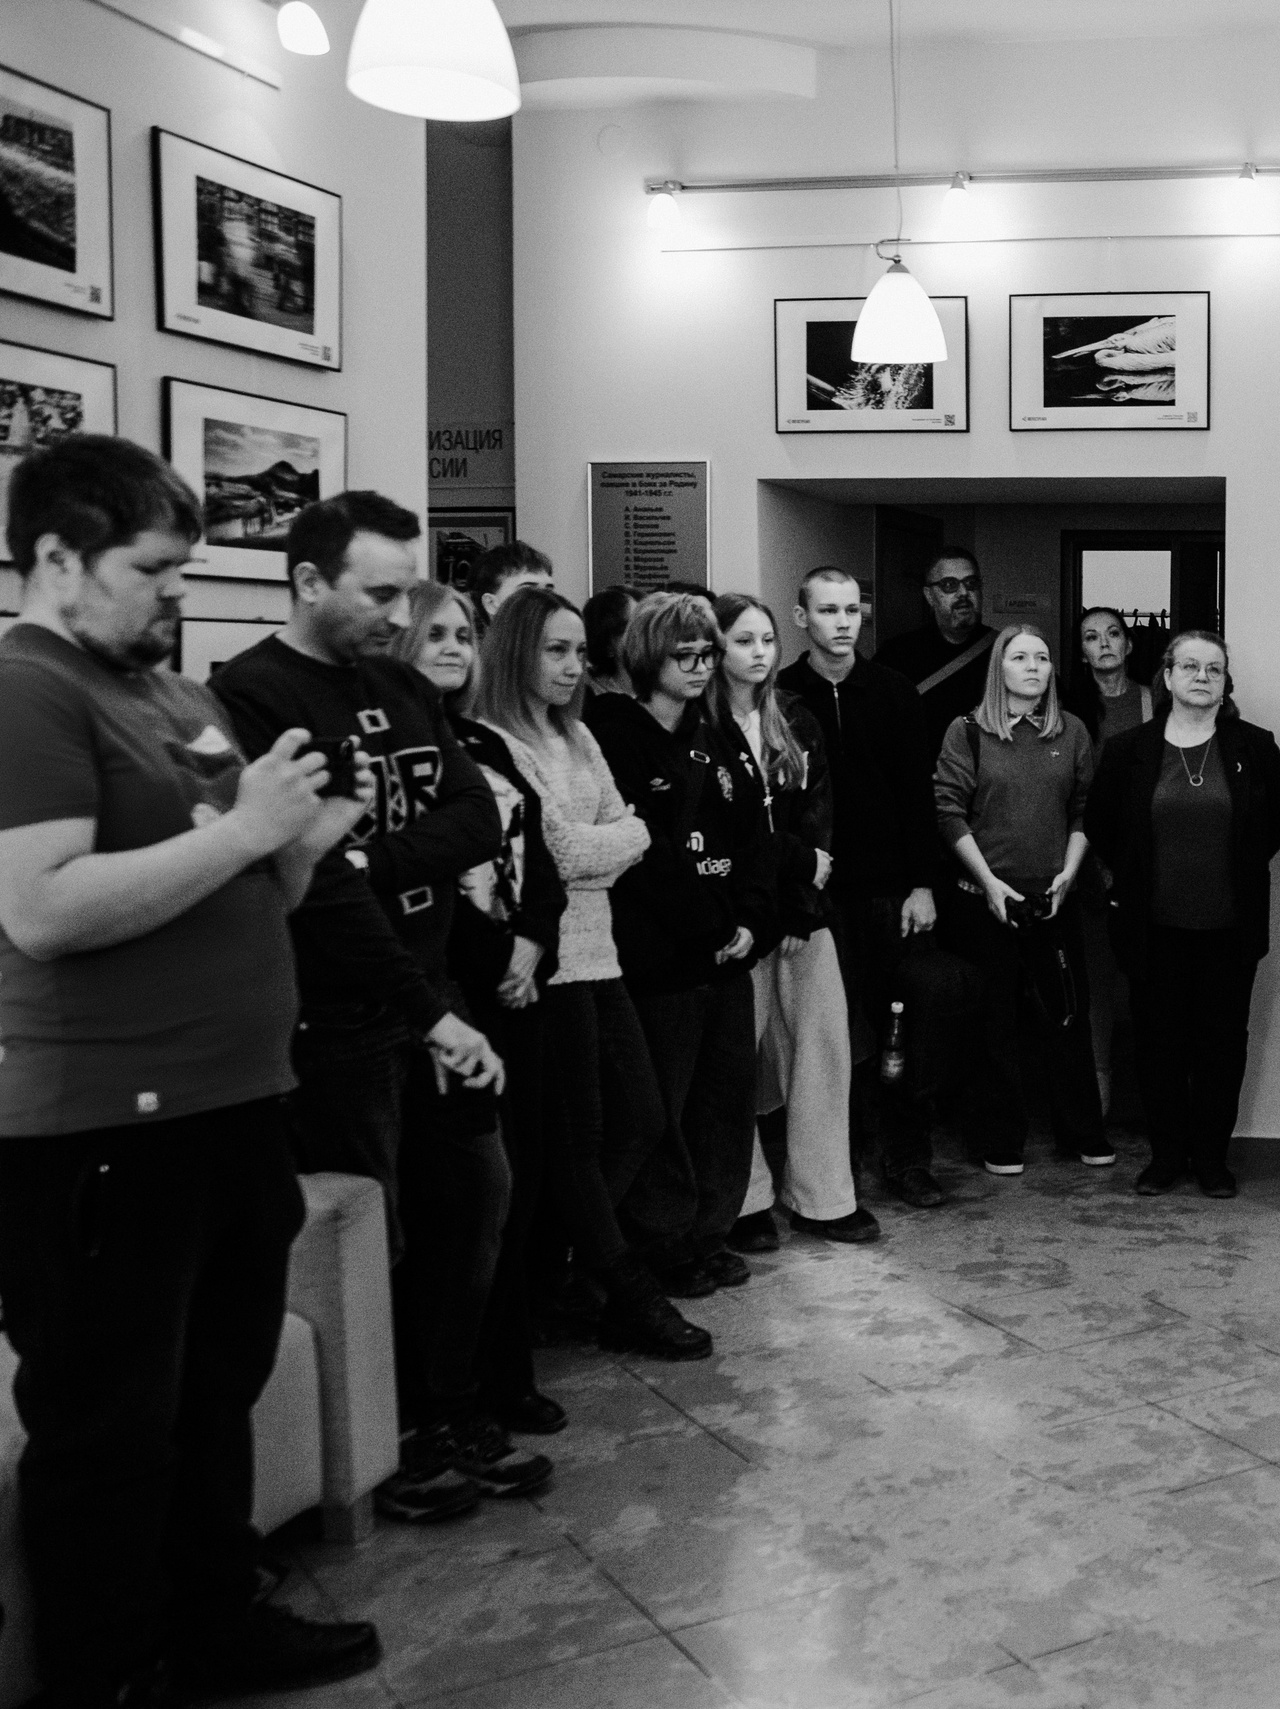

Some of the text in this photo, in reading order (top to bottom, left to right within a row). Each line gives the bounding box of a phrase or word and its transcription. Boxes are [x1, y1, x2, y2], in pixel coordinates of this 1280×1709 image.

[429, 429, 503, 453] ИЗАЦИЯ
[429, 457, 468, 478] СИИ
[669, 480, 697, 489] Родину
